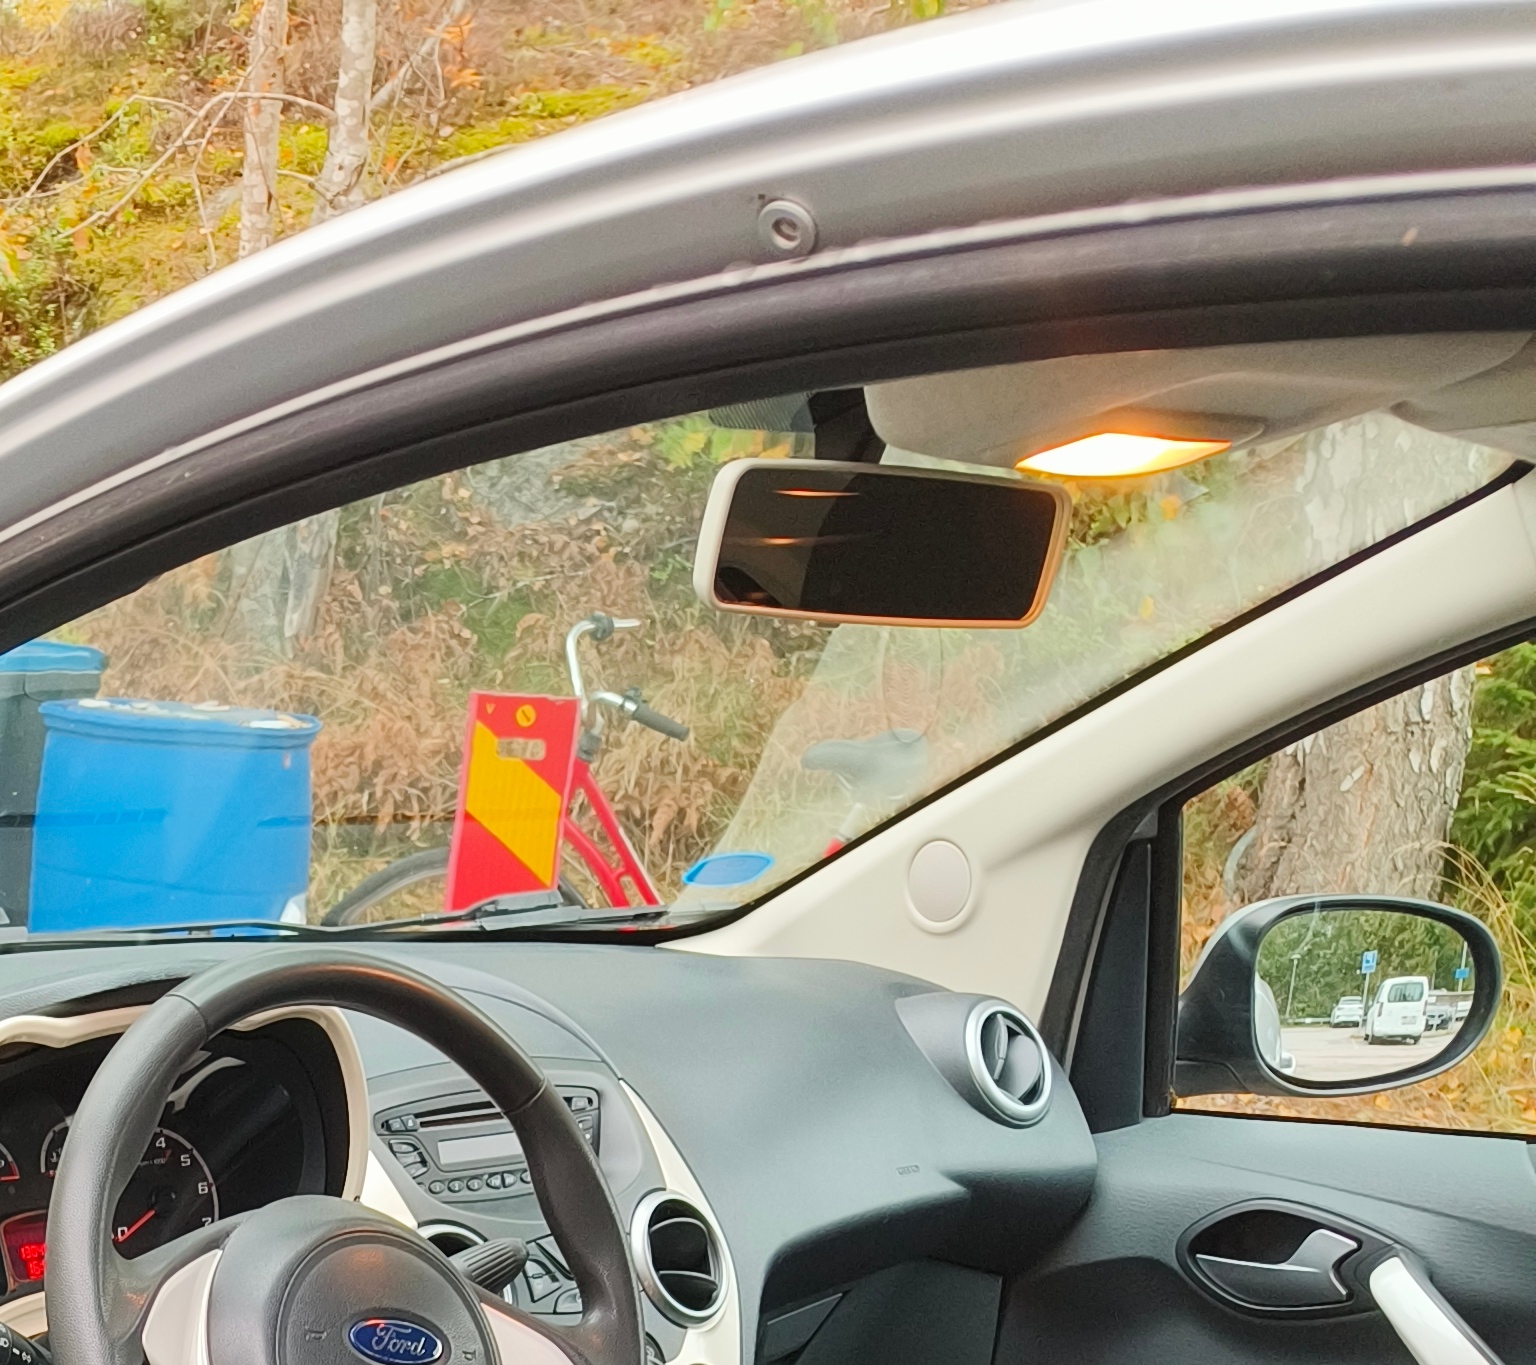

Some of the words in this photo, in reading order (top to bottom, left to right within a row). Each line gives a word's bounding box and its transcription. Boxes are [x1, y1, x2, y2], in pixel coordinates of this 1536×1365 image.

[155, 1137, 166, 1148] 4
[180, 1154, 191, 1166] 5
[198, 1182, 208, 1194] 6
[372, 1323, 426, 1357] Ford
